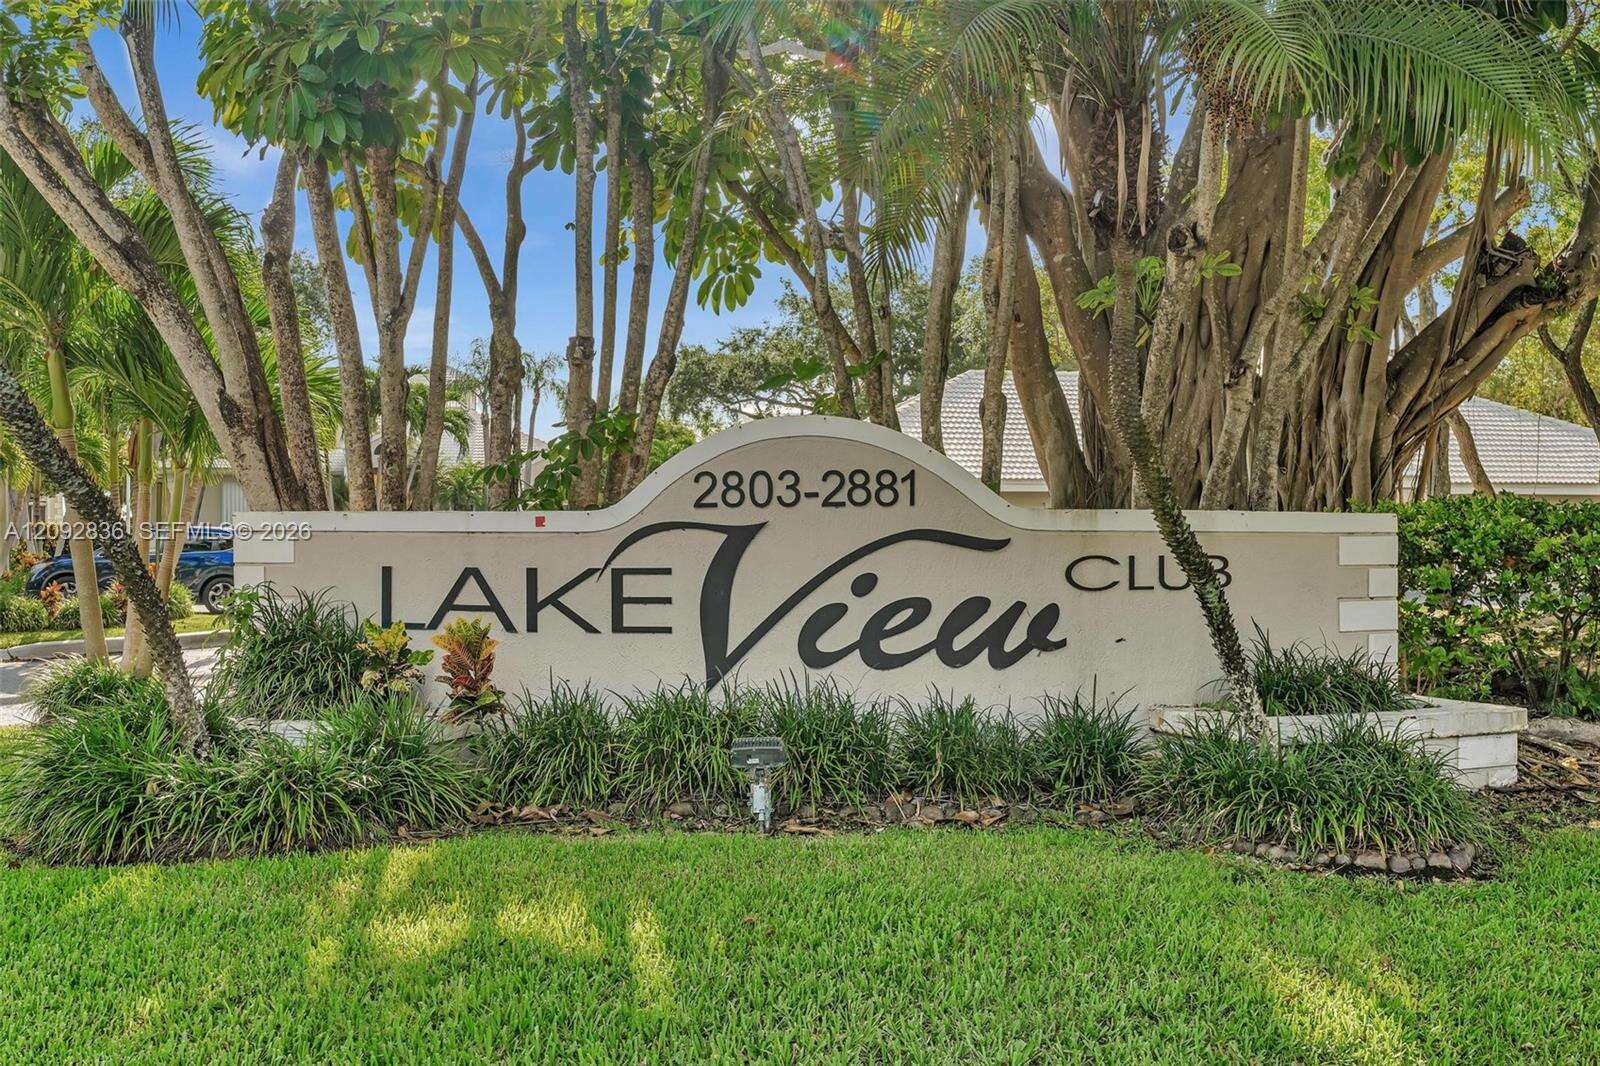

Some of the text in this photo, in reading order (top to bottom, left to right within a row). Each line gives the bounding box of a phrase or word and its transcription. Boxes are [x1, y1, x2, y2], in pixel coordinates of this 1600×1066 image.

[692, 468, 917, 508] 2803-2881
[381, 566, 673, 634] LAKE
[596, 520, 1067, 692] View
